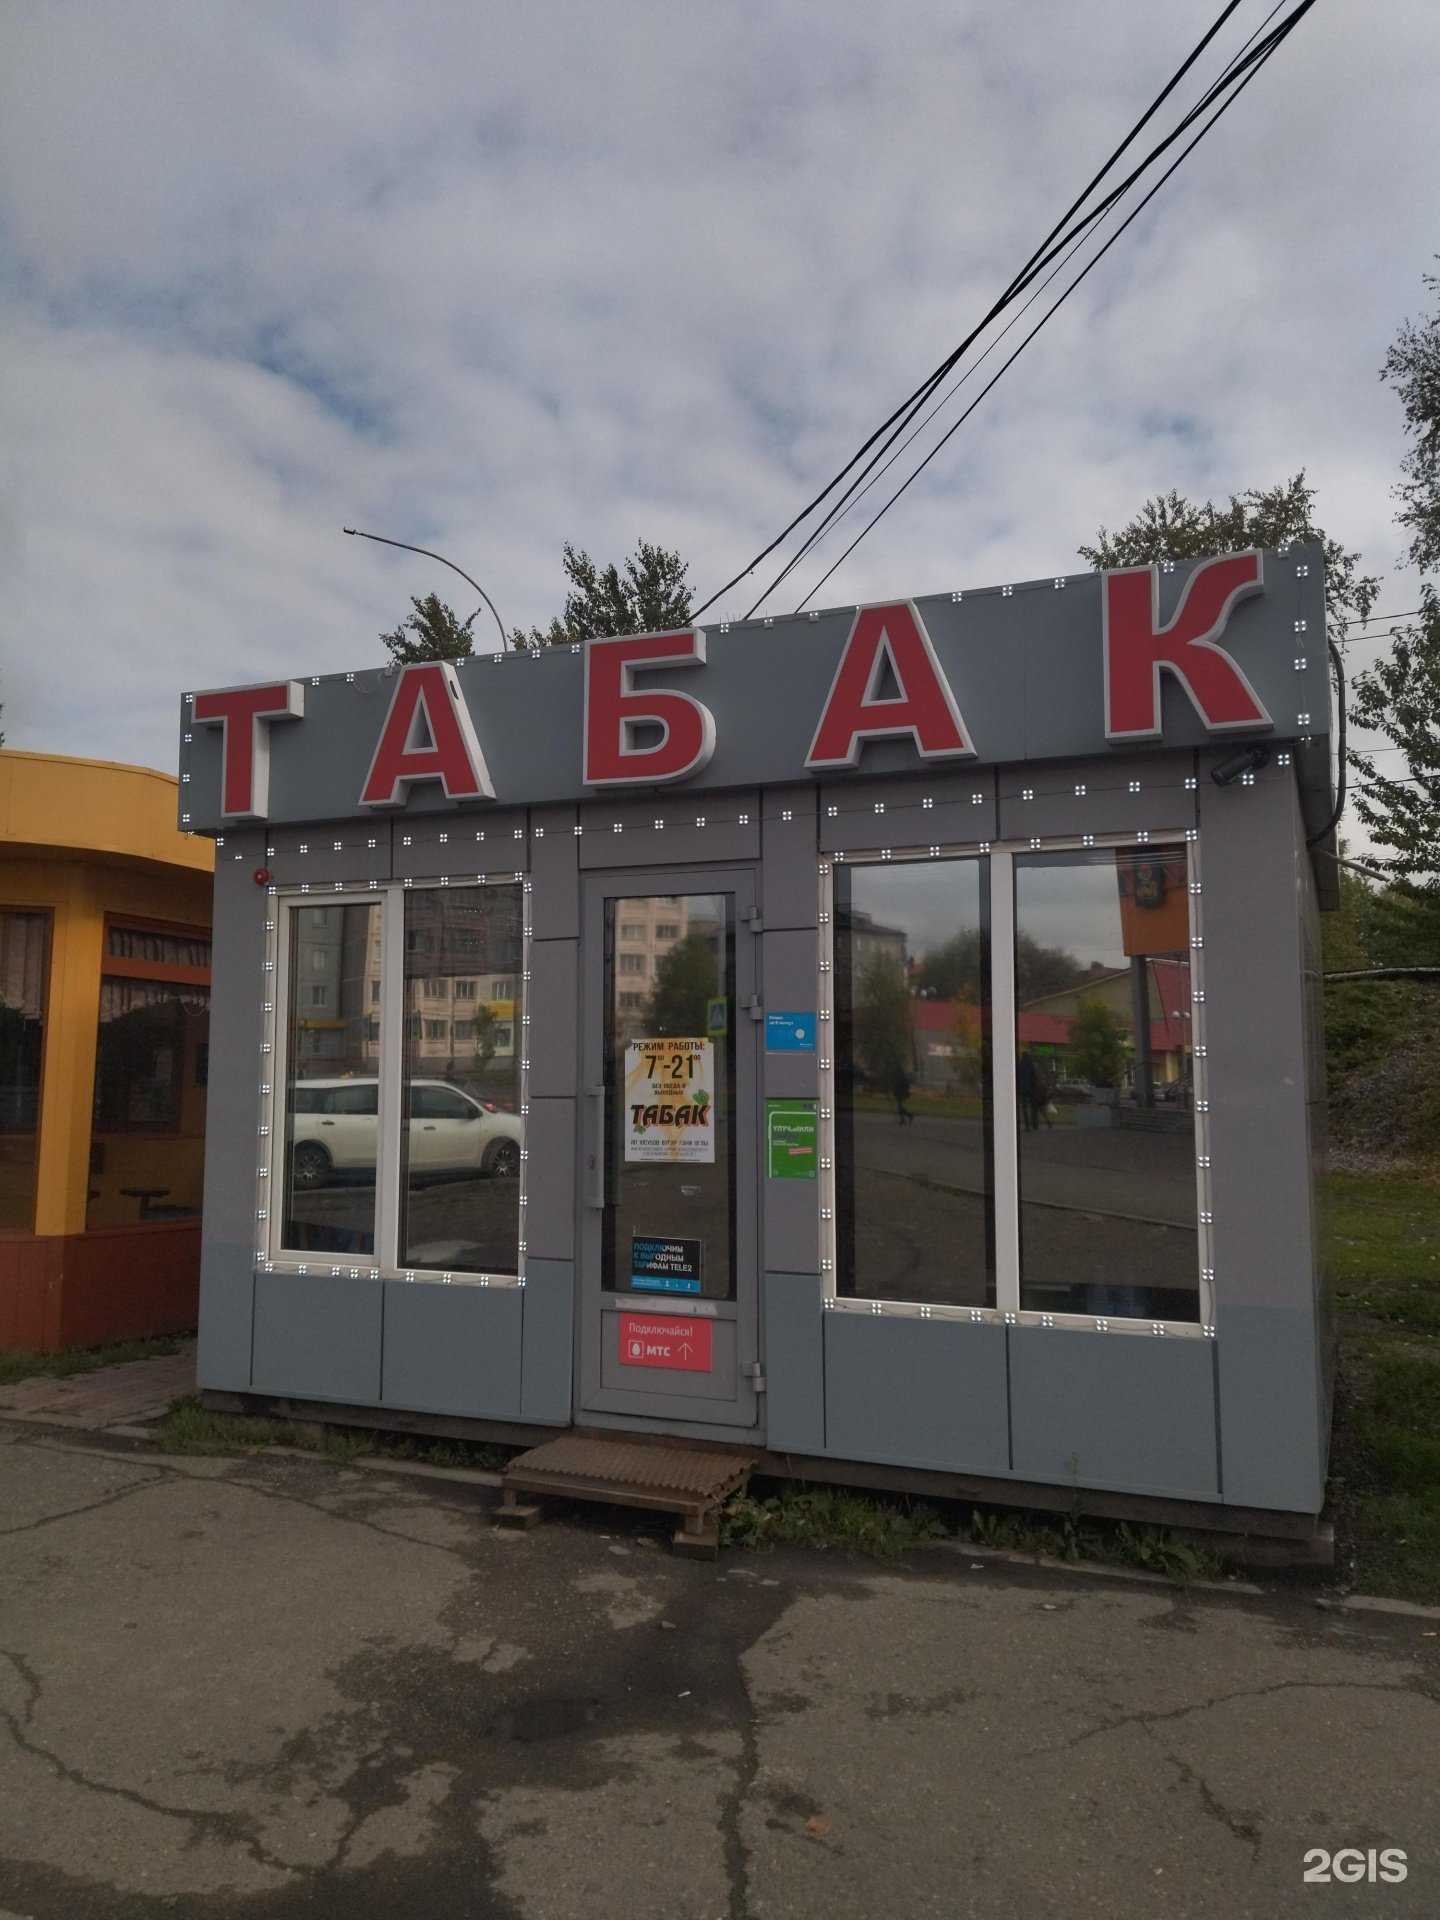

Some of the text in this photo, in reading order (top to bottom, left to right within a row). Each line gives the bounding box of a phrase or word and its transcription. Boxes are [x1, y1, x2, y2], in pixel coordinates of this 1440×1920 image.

[192, 549, 1274, 819] ТАБАК
[633, 1041, 705, 1051] РЕЖИМ РАБОТЫ:
[630, 1104, 709, 1127] ТАБАК
[670, 1263, 692, 1272] TELE2
[628, 1322, 693, 1337] Подключайся!
[647, 1345, 671, 1357] МТС
